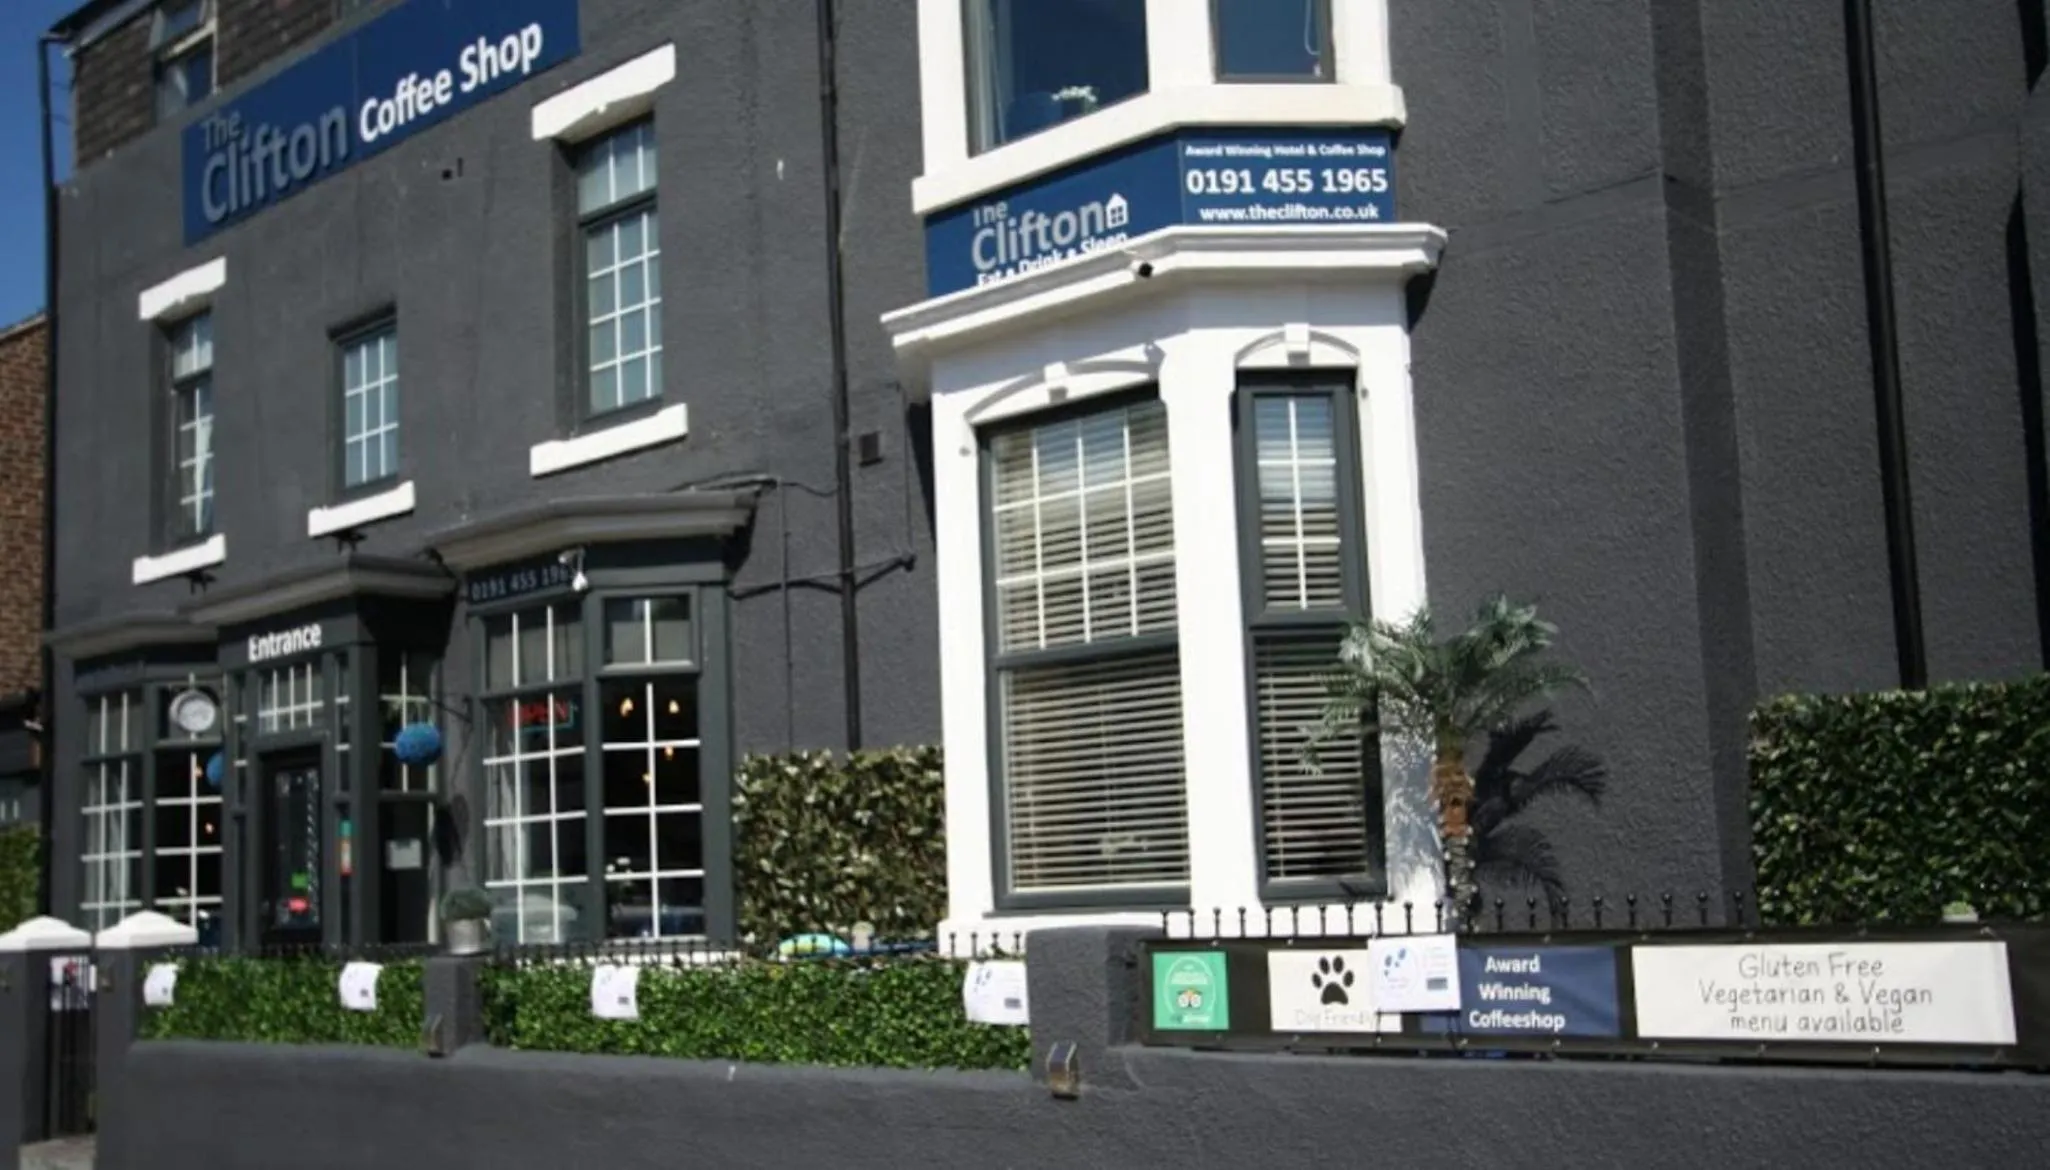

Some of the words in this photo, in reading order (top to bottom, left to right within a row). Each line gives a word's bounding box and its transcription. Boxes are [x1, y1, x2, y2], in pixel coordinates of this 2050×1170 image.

[202, 105, 348, 223] Clifton
[359, 69, 453, 143] Coffee
[459, 22, 544, 93] Shop
[203, 110, 242, 150] The
[1185, 144, 1222, 156] Award
[1225, 144, 1272, 158] Winning
[1274, 144, 1304, 156] Hotel
[1307, 144, 1317, 156] &
[1319, 144, 1354, 156] Coffee
[1357, 143, 1386, 158] Shop
[1186, 168, 1256, 194] 0191
[1262, 168, 1314, 193] 455
[1321, 168, 1389, 193] 1965
[1199, 203, 1379, 221] www.theclifton.co.uk
[972, 200, 1105, 271] Clifton
[247, 623, 322, 662] Entrance
[1485, 954, 1541, 973] Award
[1738, 953, 1820, 979] Gluten
[1827, 952, 1885, 978] Free
[1478, 982, 1552, 1005] Winning
[1698, 980, 1826, 1013] Vegetarian
[1834, 982, 1850, 1001] &
[1858, 979, 1934, 1014] Vegan
[1469, 1008, 1566, 1032] Coffeeshop
[1730, 1013, 1788, 1034] menu
[1797, 1008, 1906, 1034] available
